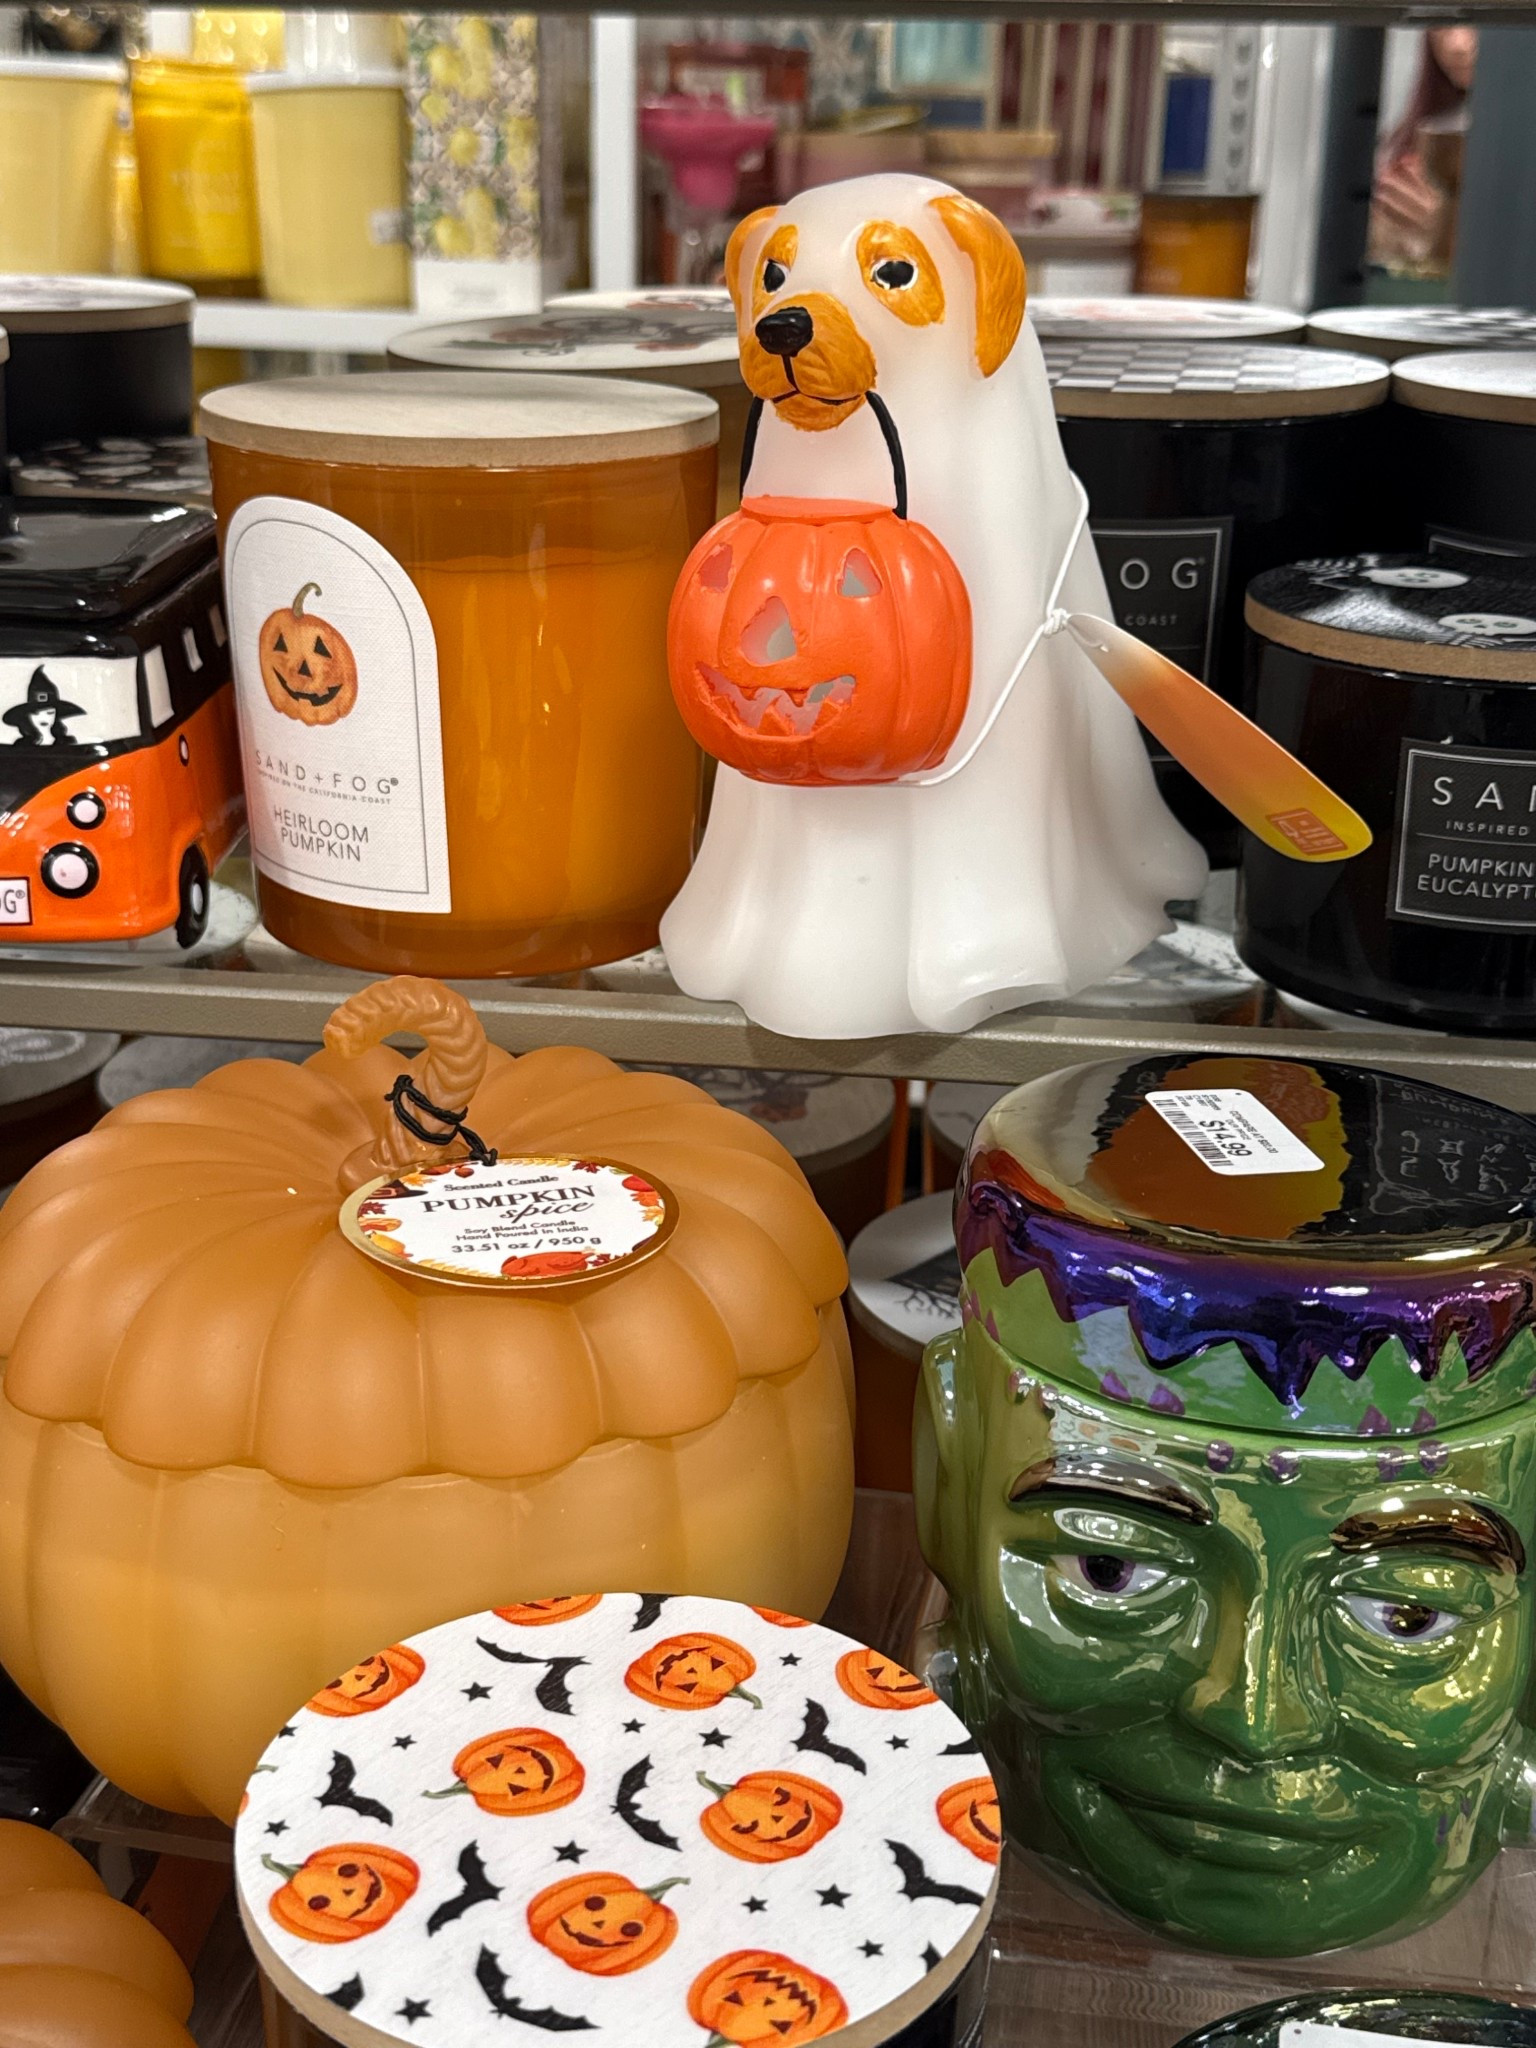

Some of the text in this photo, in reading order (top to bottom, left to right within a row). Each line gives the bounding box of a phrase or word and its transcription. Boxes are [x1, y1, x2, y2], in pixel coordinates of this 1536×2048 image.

[1120, 557, 1199, 590] OG
[1123, 614, 1178, 626] COAST
[308, 786, 358, 802] CALIFORNIA
[361, 796, 392, 805] COAST
[273, 804, 370, 844] HEIRLOOM
[1445, 820, 1530, 837] INSPIRED
[281, 826, 362, 863] PUMPKIN
[1427, 853, 1535, 879] PUMPKIN
[1416, 874, 1536, 900] EUCALYPT
[1199, 1120, 1253, 1157] $14.99
[443, 1175, 559, 1192] Scented Candle
[420, 1185, 596, 1213] PUMPKIN
[499, 1201, 595, 1224] spice
[456, 1232, 492, 1241] Hand
[495, 1228, 538, 1238] Poured
[557, 1225, 589, 1233] India
[492, 1223, 527, 1233] Blend
[530, 1220, 576, 1229] Candle
[451, 1236, 602, 1253] 33.51 oz / 950 g
